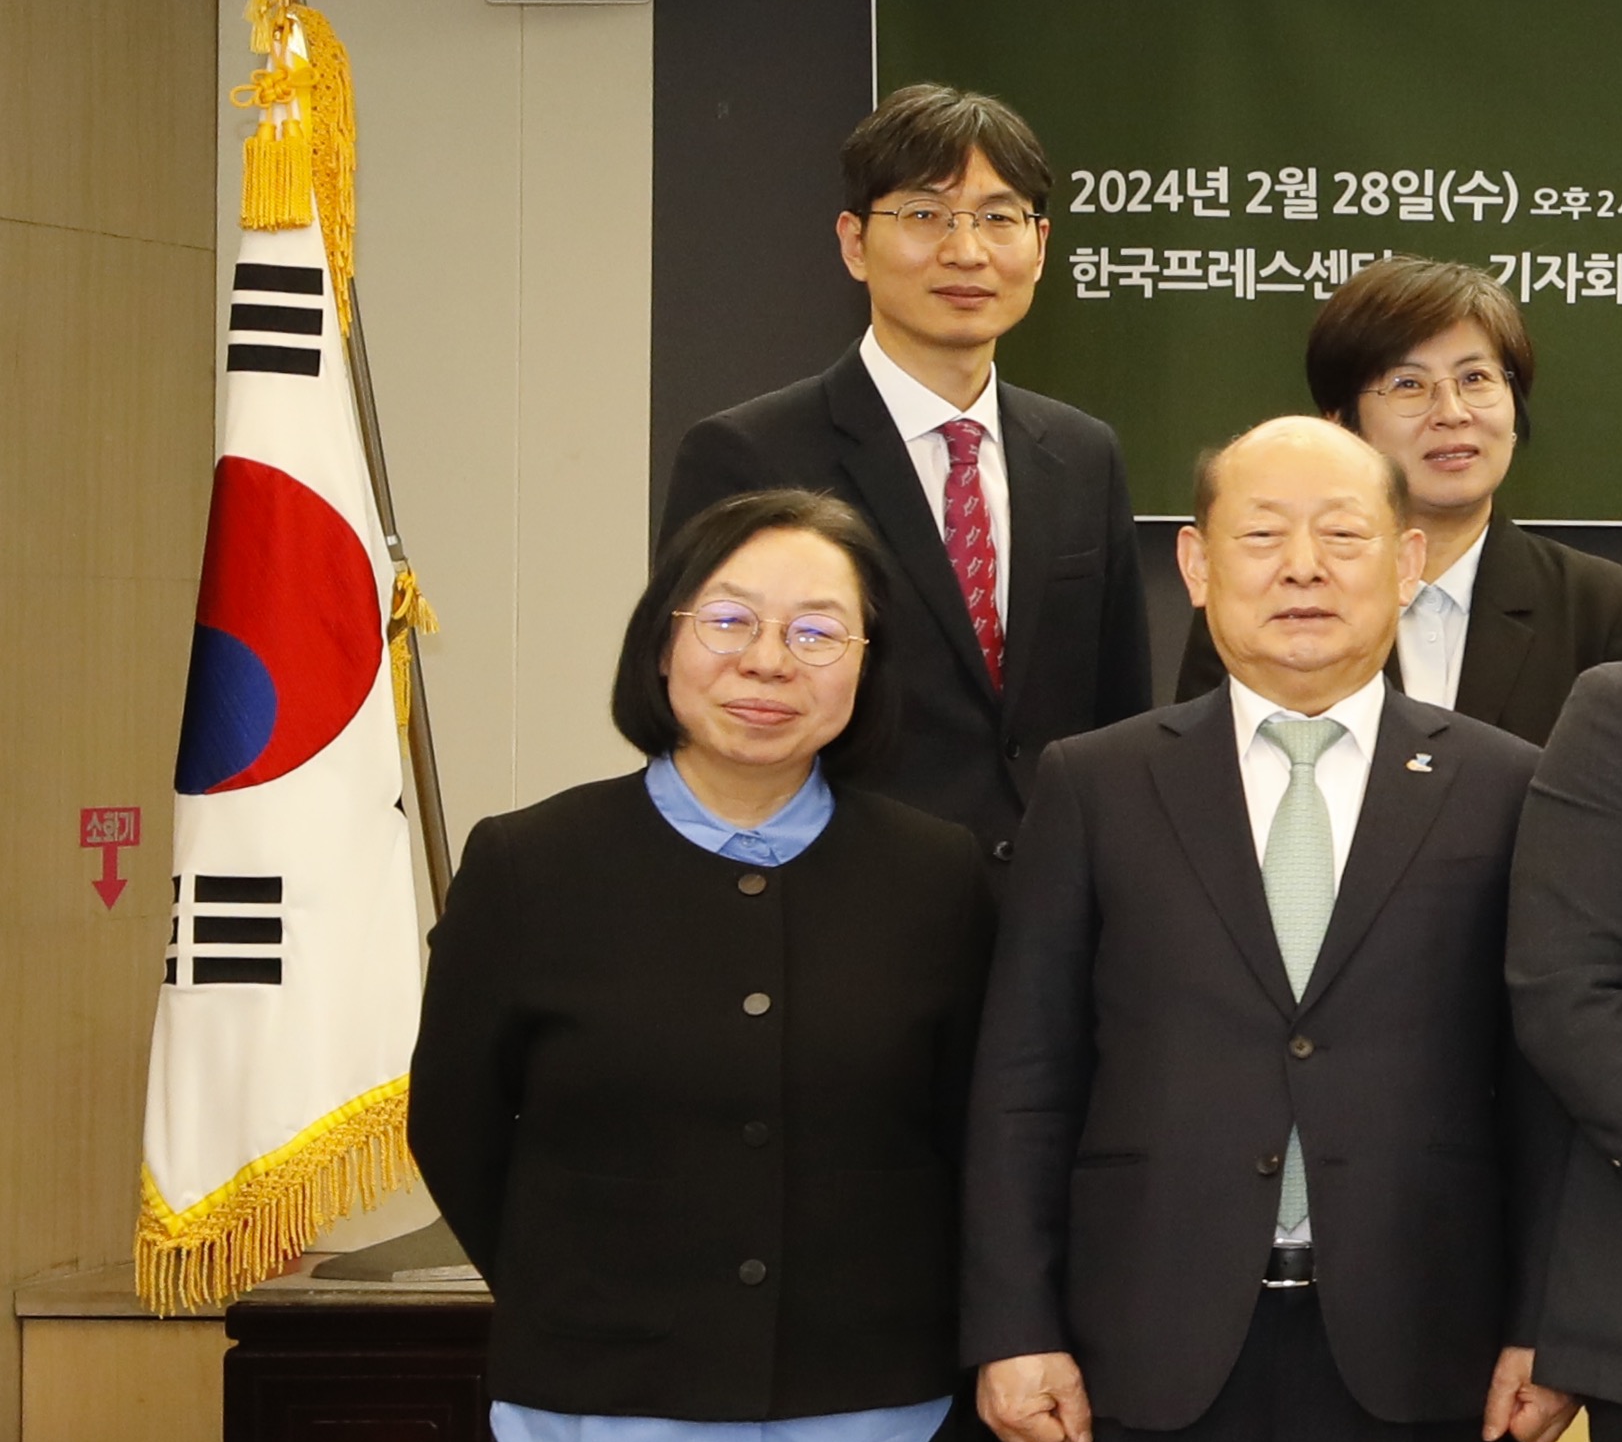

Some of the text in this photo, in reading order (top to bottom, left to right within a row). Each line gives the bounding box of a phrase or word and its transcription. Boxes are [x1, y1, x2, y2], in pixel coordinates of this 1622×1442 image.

[1069, 166, 1230, 218] 2024년
[1246, 167, 1318, 220] 2월
[1333, 169, 1519, 224] 28일(수)
[1069, 247, 1393, 300] 한국프레스센
[86, 811, 135, 843] 소화기
